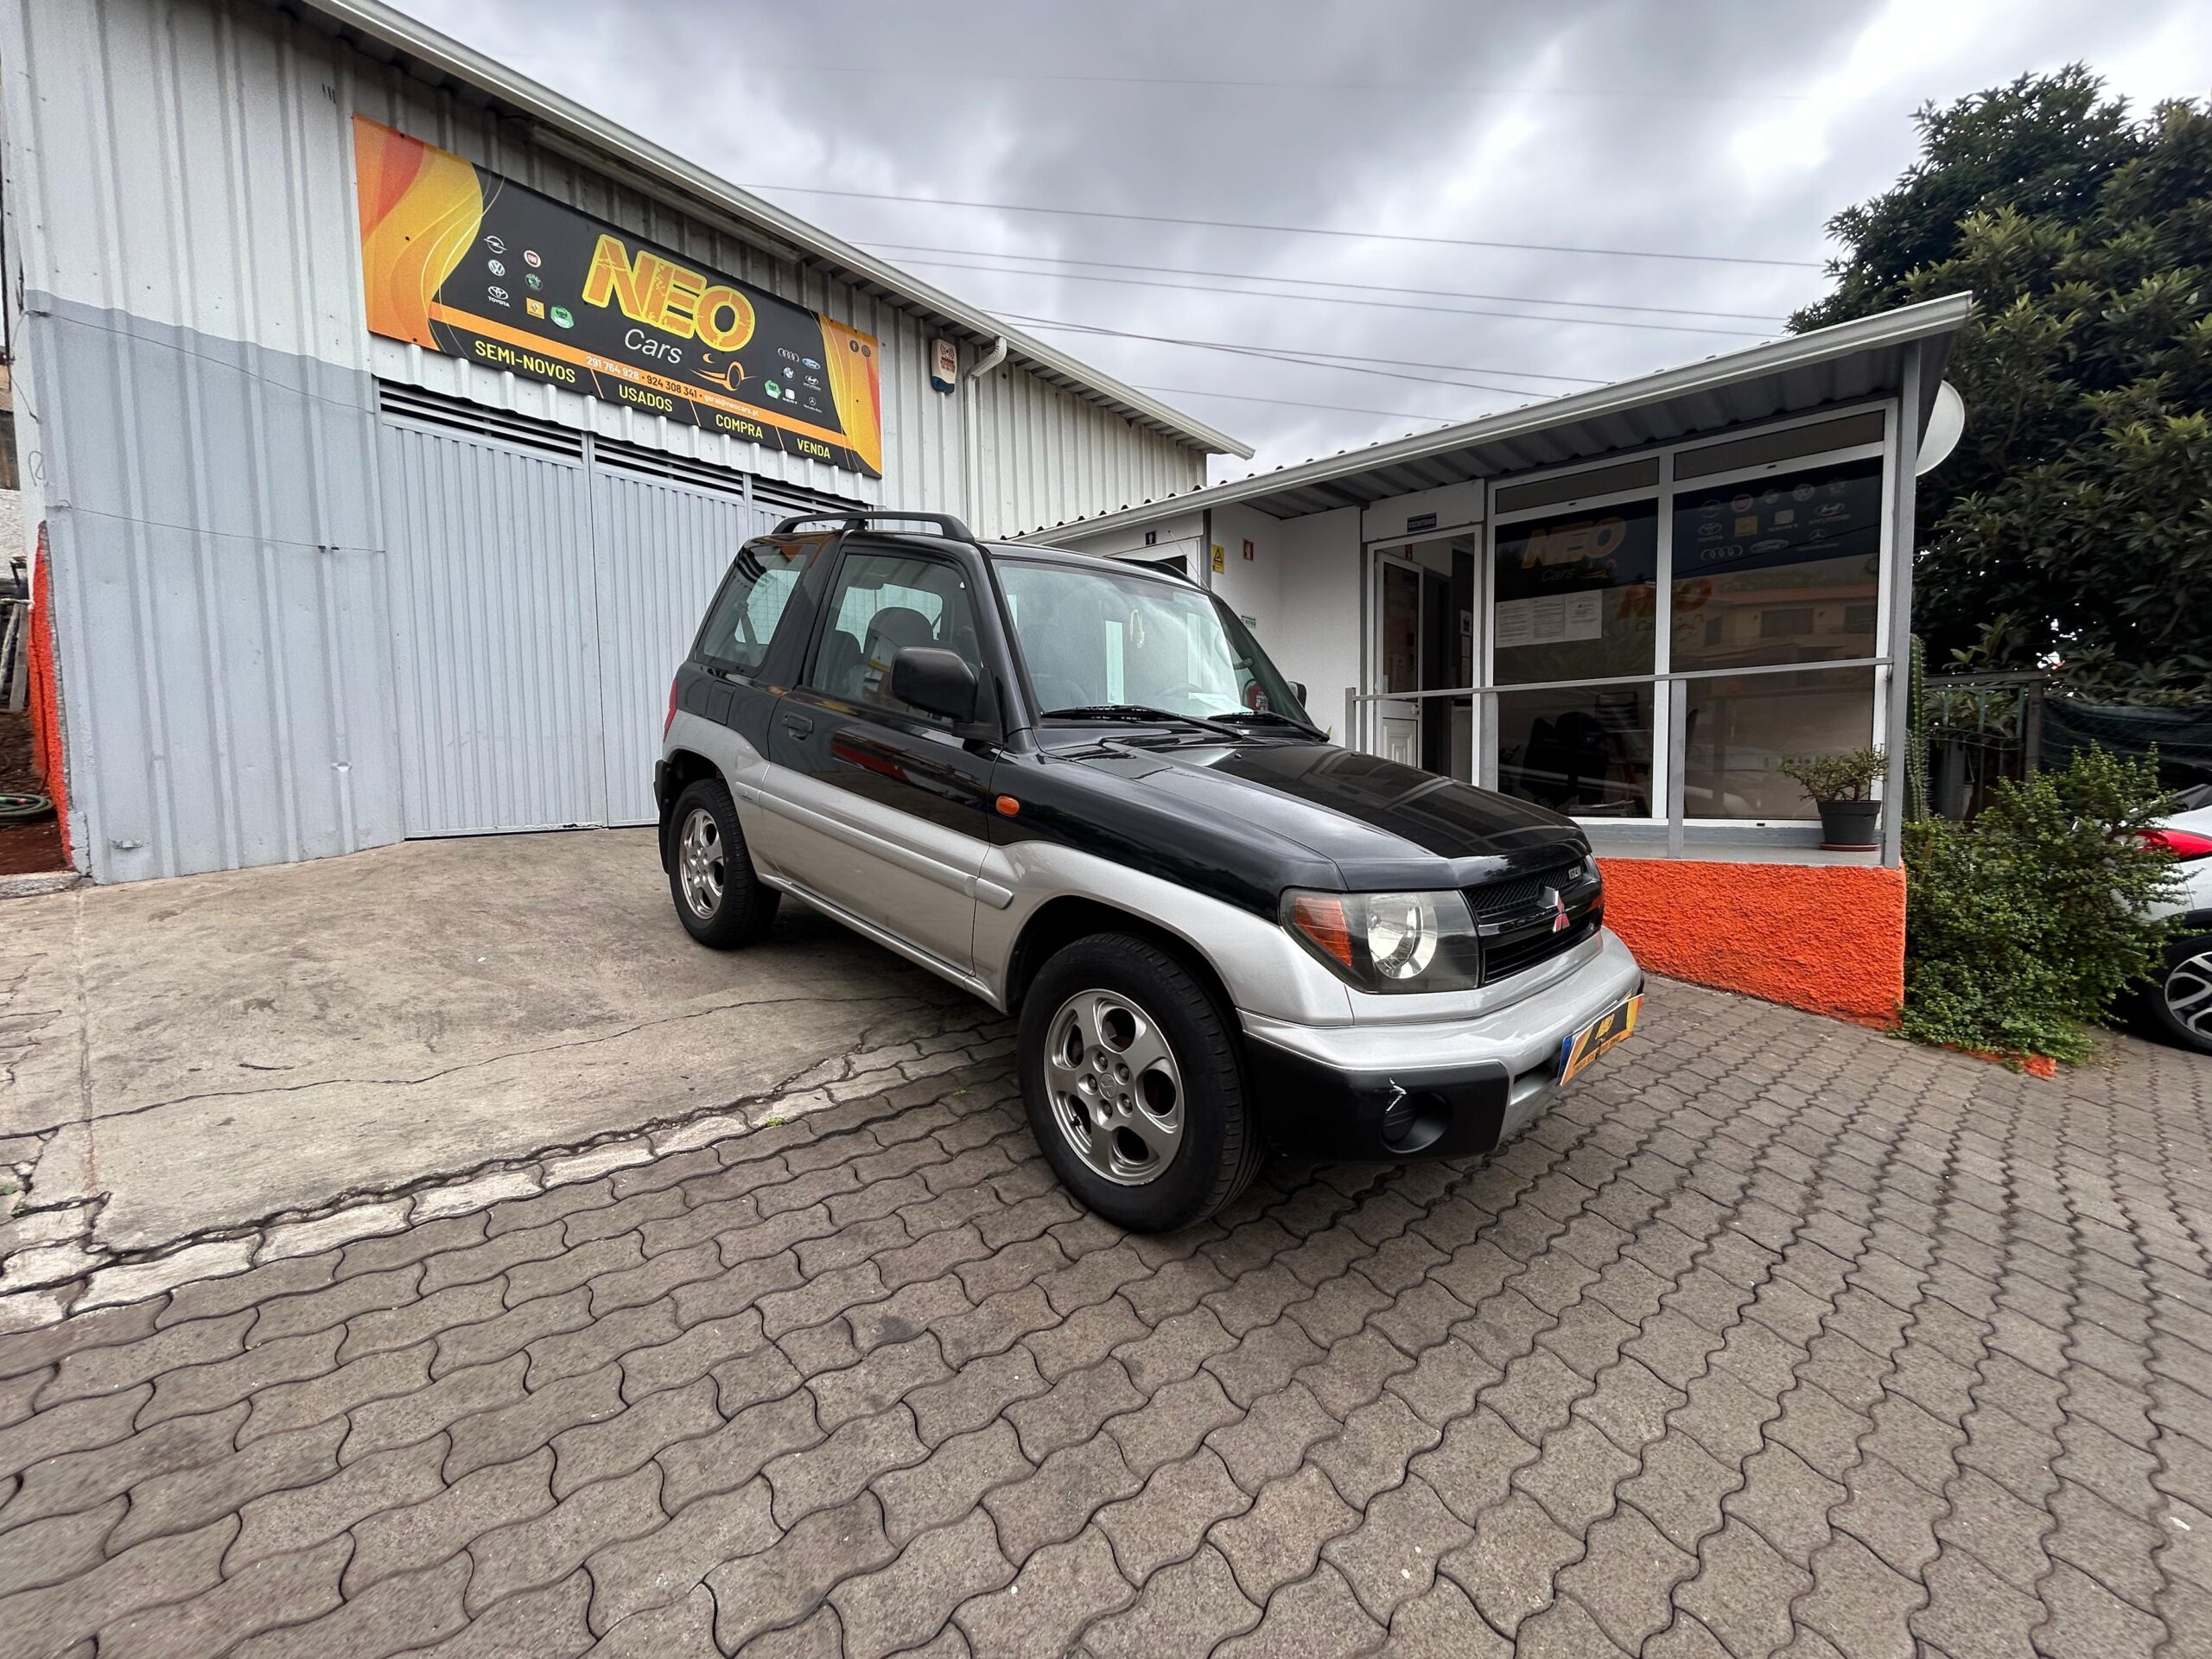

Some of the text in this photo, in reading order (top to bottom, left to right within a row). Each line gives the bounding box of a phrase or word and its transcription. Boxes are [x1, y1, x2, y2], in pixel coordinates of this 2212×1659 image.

[486, 296, 511, 308] TOYOTA
[582, 233, 755, 353] NEO
[474, 340, 576, 384] SEMI-NOVOS
[625, 328, 683, 364] Cars
[586, 355, 602, 369] 291
[604, 360, 621, 374] 764
[621, 366, 640, 380] 928
[646, 375, 664, 388] 924
[664, 381, 682, 393] 308
[683, 385, 697, 398] 341
[619, 384, 673, 412] USADOS
[715, 413, 764, 440] COMPRA
[796, 438, 831, 460] VENDA
[1521, 517, 1627, 569] NEO
[1541, 568, 1576, 582] Cars
